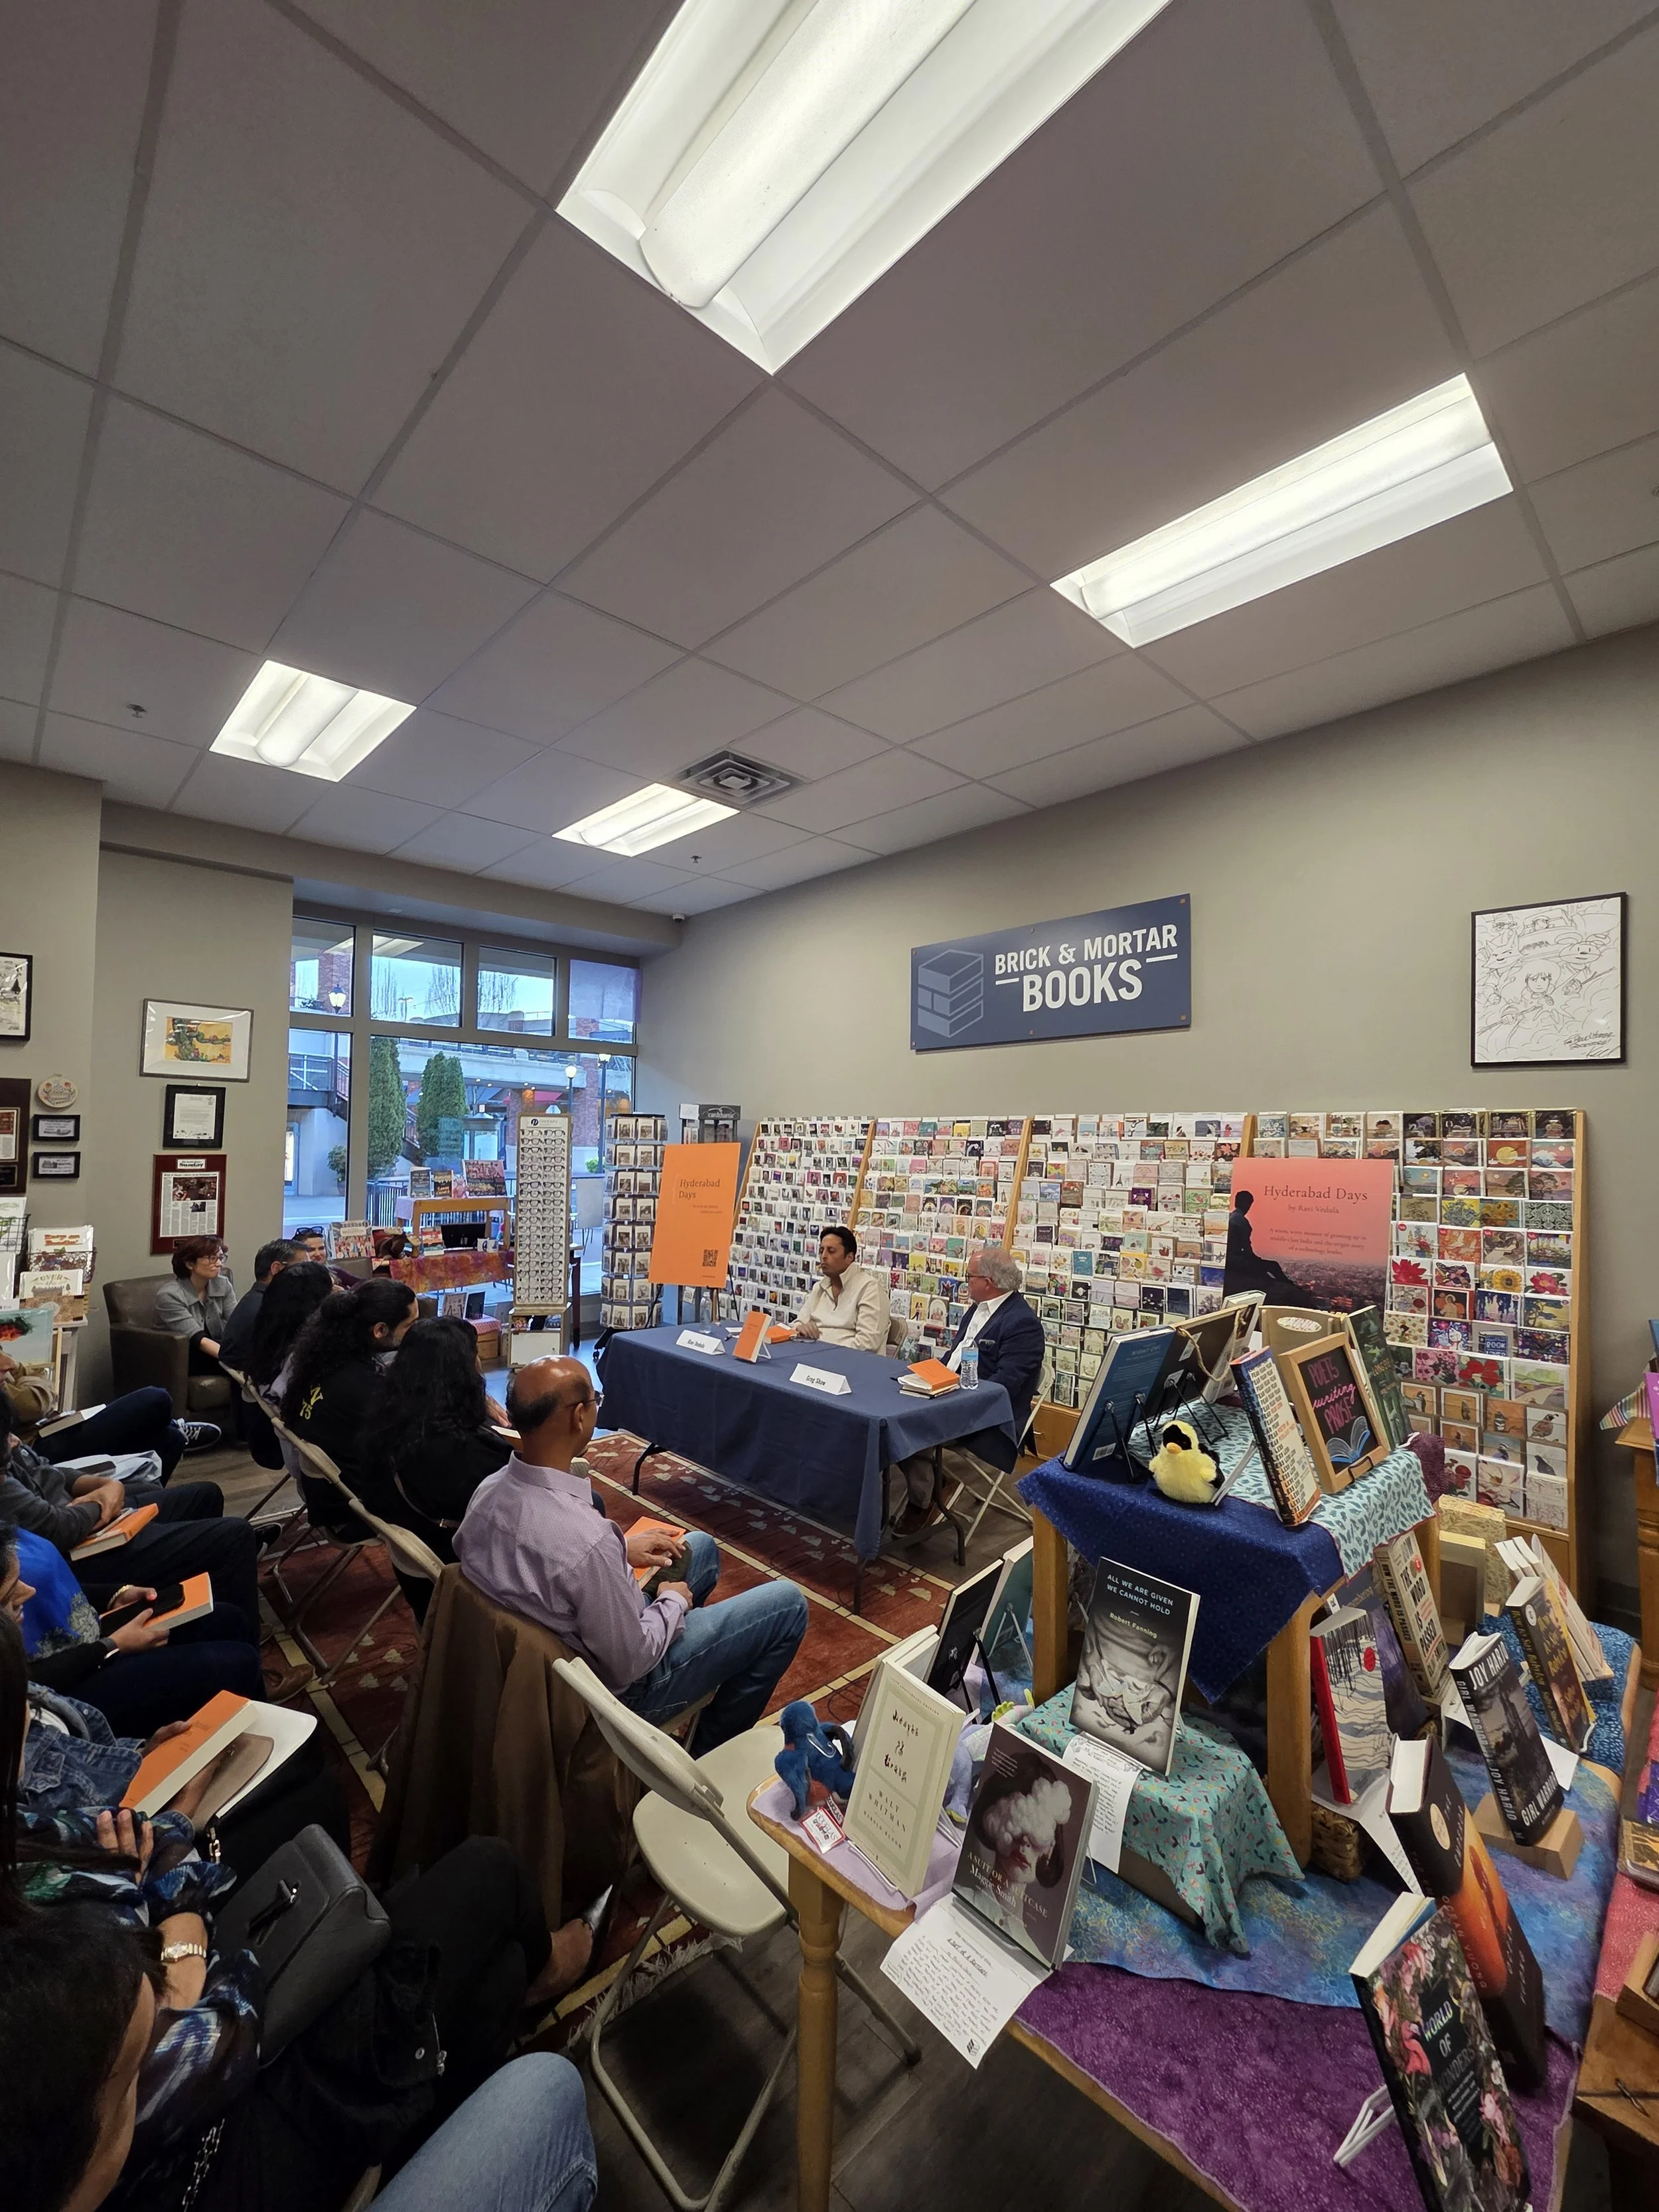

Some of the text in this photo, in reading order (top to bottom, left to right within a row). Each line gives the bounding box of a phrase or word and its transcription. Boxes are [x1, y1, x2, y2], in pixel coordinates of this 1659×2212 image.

[995, 924, 1178, 975] BRICK & MORTAR
[1023, 959, 1143, 1012] BOOKS
[678, 1191, 697, 1203] Days
[680, 1179, 721, 1189] Hyderabad
[1264, 1185, 1368, 1205] Hyderabad Days
[1288, 1204, 1295, 1213] by
[1315, 1205, 1339, 1214] Vedula
[806, 1374, 826, 1386] Greg Shaw
[1308, 1357, 1339, 1388] POETS
[1313, 1383, 1356, 1410] writing
[1324, 1396, 1356, 1435] PROSE
[1381, 1562, 1392, 1578] HOW
[1385, 1577, 1395, 1589] THE
[1400, 1566, 1412, 1592] THE
[1107, 1574, 1173, 1606] ALL WE ARE GIVEN
[1107, 1584, 1171, 1615] WE CANNOT HOLD
[1389, 1590, 1401, 1608] WORD
[1410, 1577, 1426, 1608] WORD
[1110, 1612, 1158, 1639] Robert Fanning
[1397, 1616, 1412, 1642] PASSED
[1415, 1611, 1423, 1633] IS
[1508, 1608, 1524, 1627] How
[1419, 1618, 1437, 1658] PASSED
[1520, 1637, 1534, 1653] Say
[1469, 1662, 1488, 1691] JOY
[1486, 1642, 1509, 1677] HARJO
[1525, 1652, 1548, 1687] Babylon
[893, 1709, 919, 1737] Leaves
[1457, 1681, 1471, 1700] GIRL
[1466, 1704, 1488, 1745] WARRIOR
[879, 1791, 900, 1812] WALT
[1489, 1767, 1518, 1820] JOY HARJO
[1521, 1801, 1540, 1826] GIRL
[1536, 1771, 1558, 1810] WARRIOR
[816, 1812, 837, 1840] DOUGLAS
[869, 1793, 905, 1832] WHITMAN
[968, 1852, 973, 1860] A
[974, 1856, 991, 1873] SUIT
[992, 1870, 1003, 1883] OR
[1003, 1879, 1009, 1888] A
[1011, 1883, 1048, 1918] SUITCASE
[970, 1864, 1017, 1908] Maggie Smith
[1441, 1895, 1487, 1988] OCEAN VUONG
[1421, 2000, 1453, 2042] WORLD
[1439, 2032, 1452, 2057] OF
